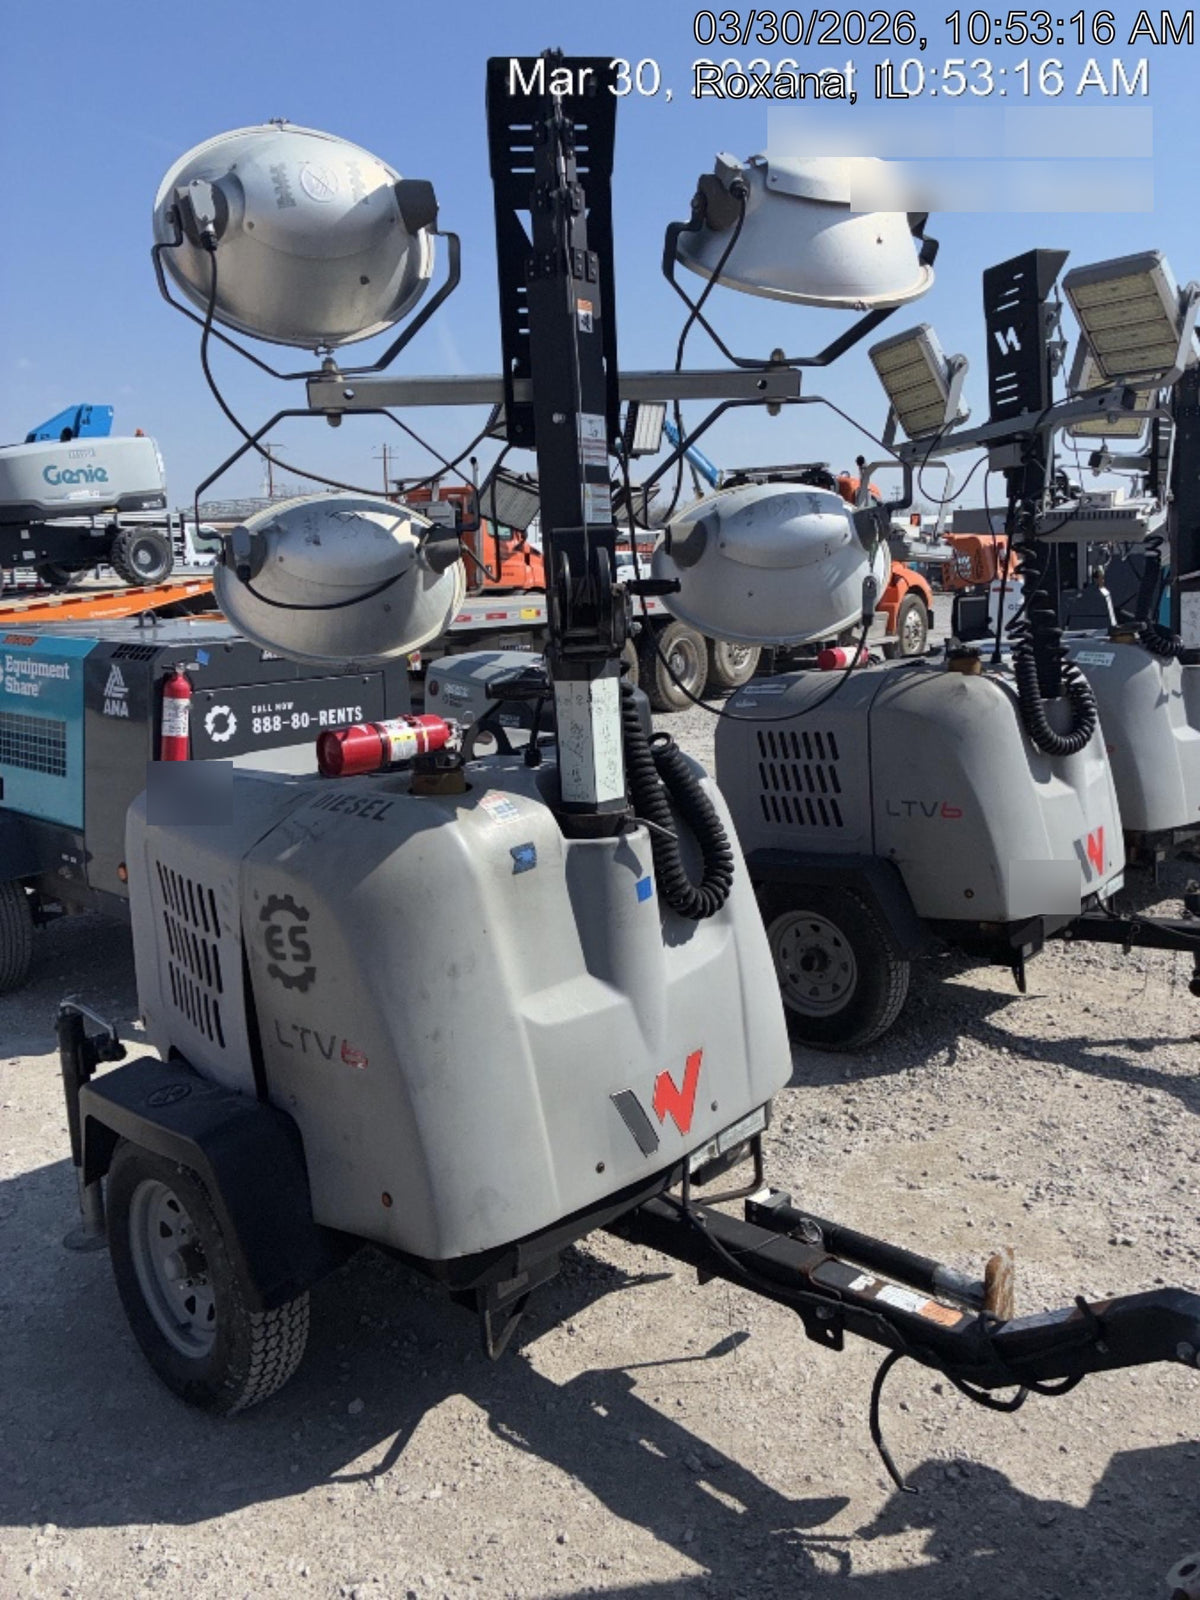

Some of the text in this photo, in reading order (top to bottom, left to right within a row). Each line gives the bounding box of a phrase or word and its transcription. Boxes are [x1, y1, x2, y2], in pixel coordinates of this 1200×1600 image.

[42, 463, 109, 486] Genie
[4, 654, 71, 680] Equipment
[4, 676, 40, 697] Share
[103, 698, 129, 718] ANA
[251, 701, 295, 714] CALL NOW
[251, 705, 363, 734] 888-80-RENTS
[310, 792, 395, 821] DIESEL
[886, 801, 964, 820] LTV6
[264, 924, 312, 963] ES
[274, 1018, 369, 1070] LTV6
